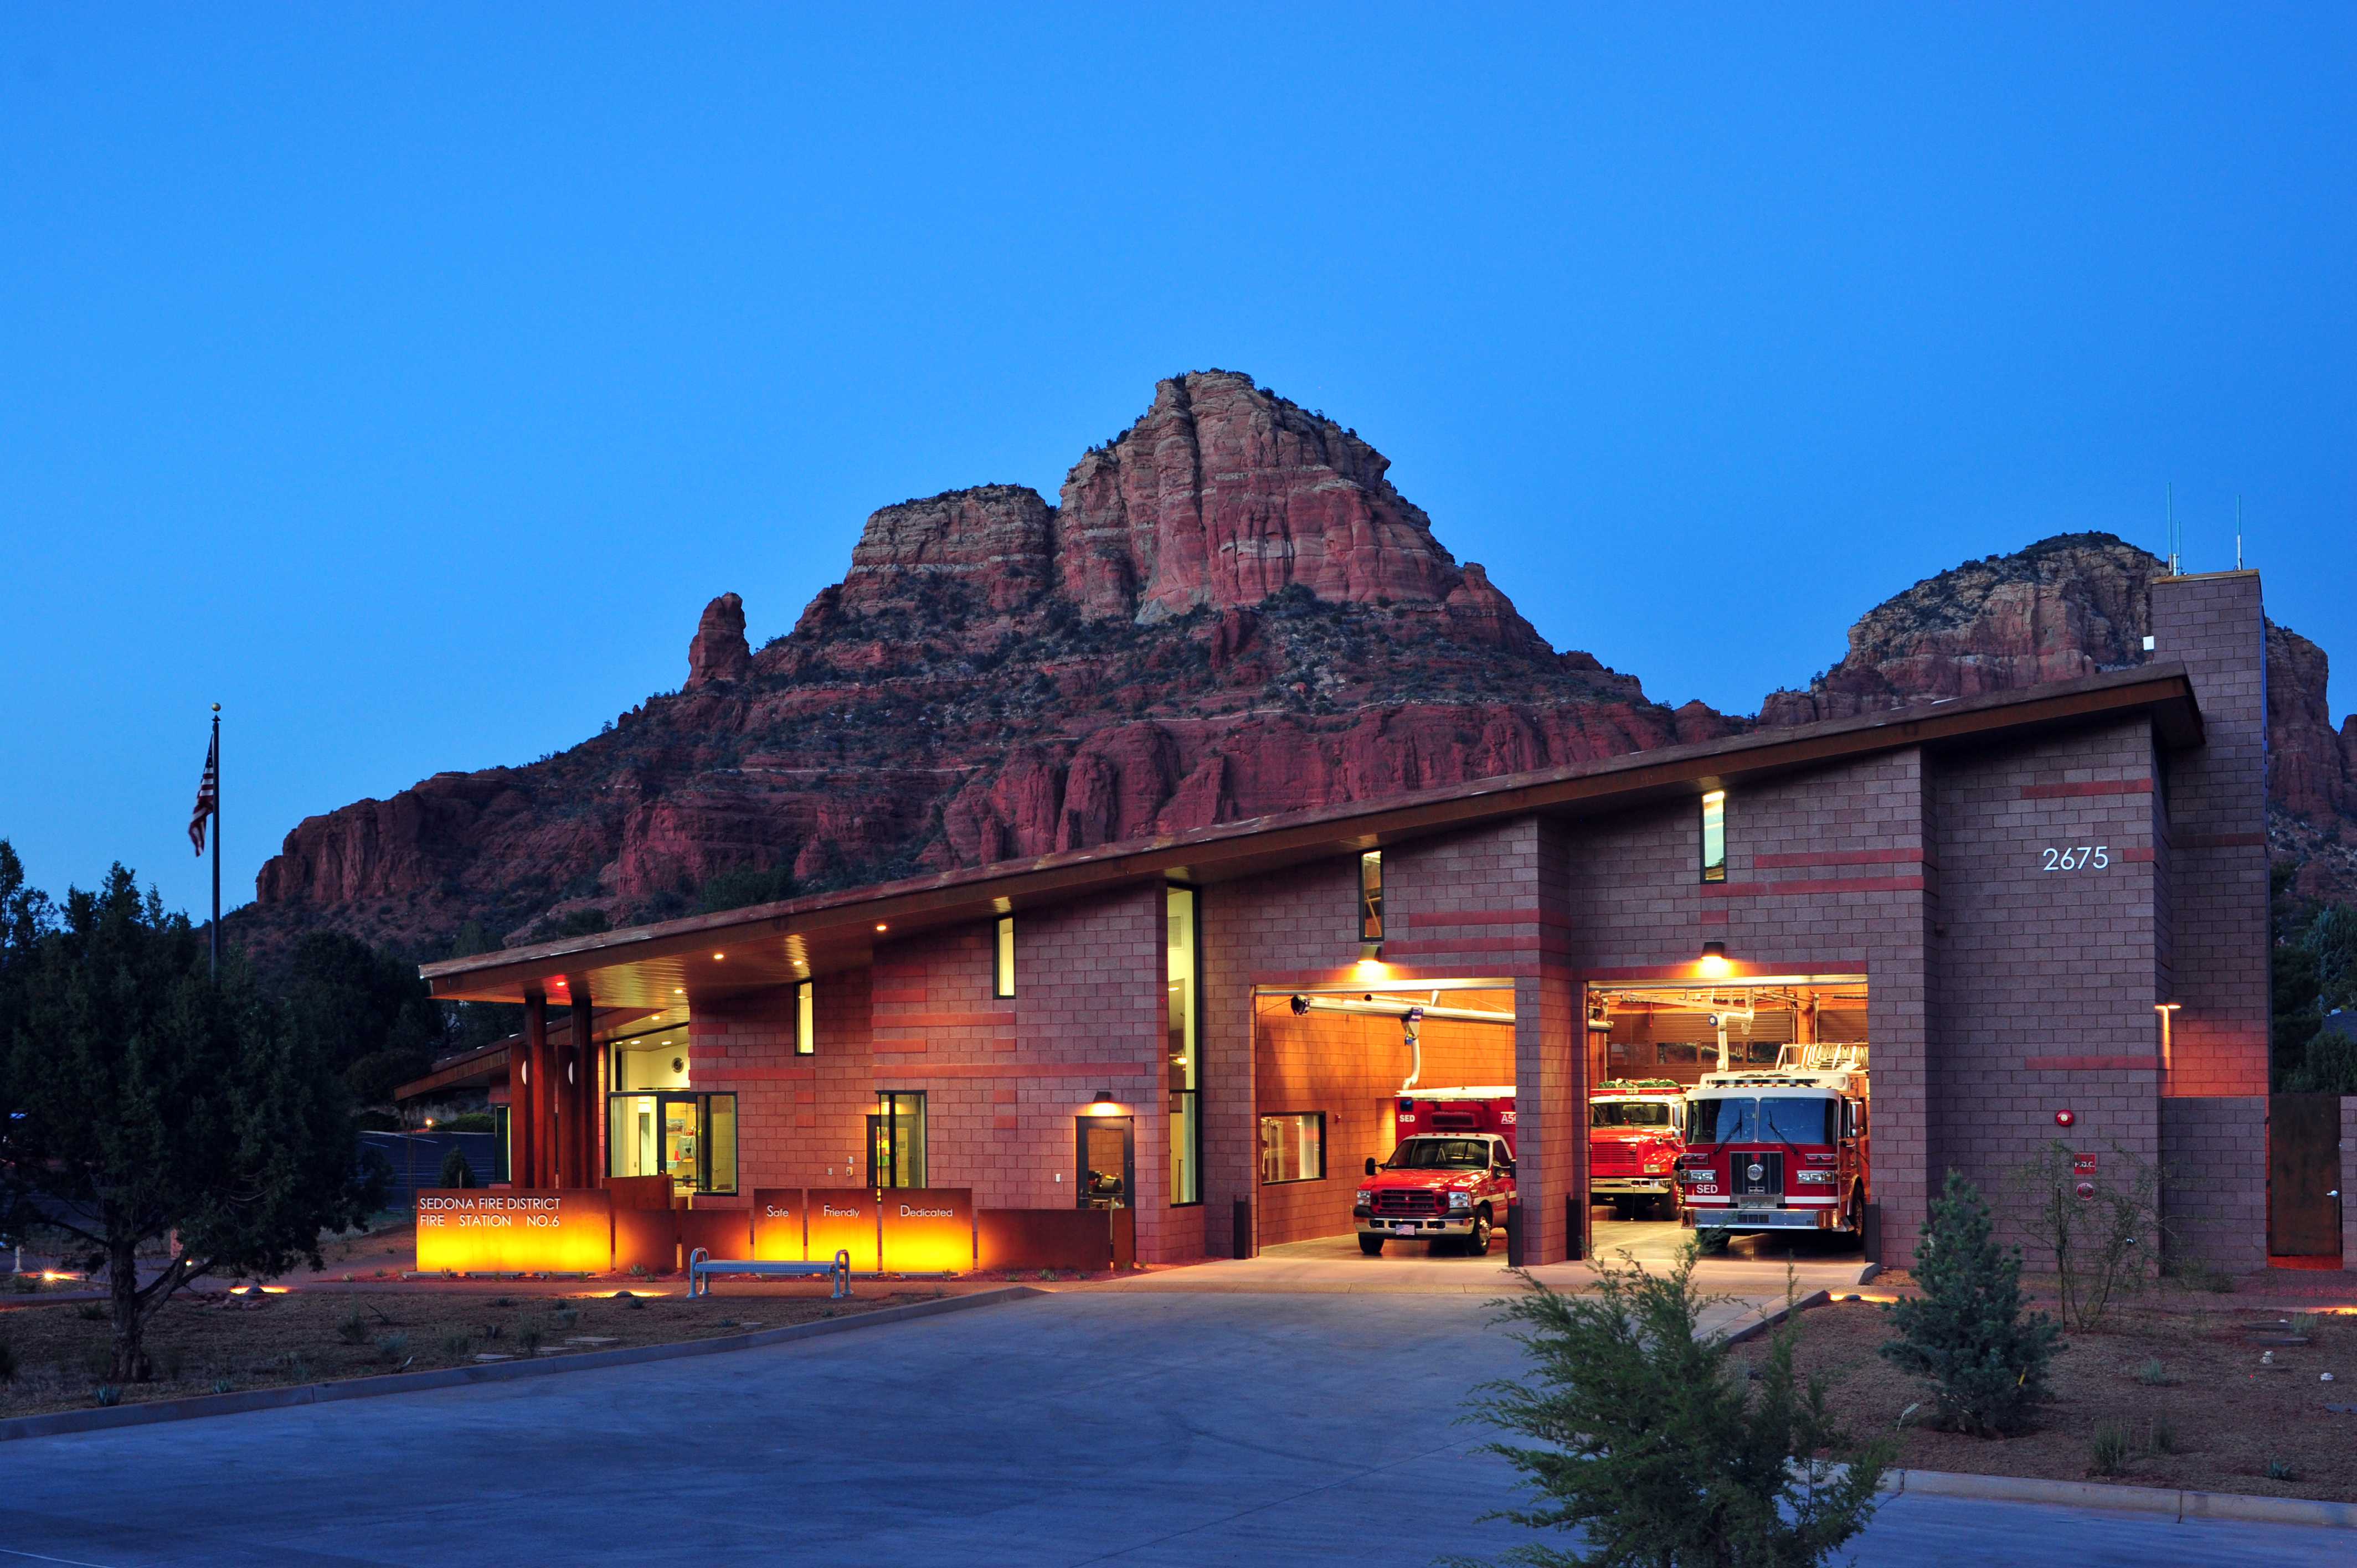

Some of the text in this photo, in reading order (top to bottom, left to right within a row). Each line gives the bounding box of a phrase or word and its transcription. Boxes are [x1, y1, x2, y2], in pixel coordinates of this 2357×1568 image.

[2042, 846, 2108, 870] 2675
[1399, 1114, 1416, 1122] SED
[1696, 1184, 1718, 1194] SED
[419, 1198, 561, 1210] SEDONA FIRE DISTRICT
[766, 1205, 789, 1217] Safe
[824, 1205, 860, 1218] Friendly
[900, 1205, 953, 1217] Dedicated
[420, 1214, 560, 1227] FIRE STATION NO.6
